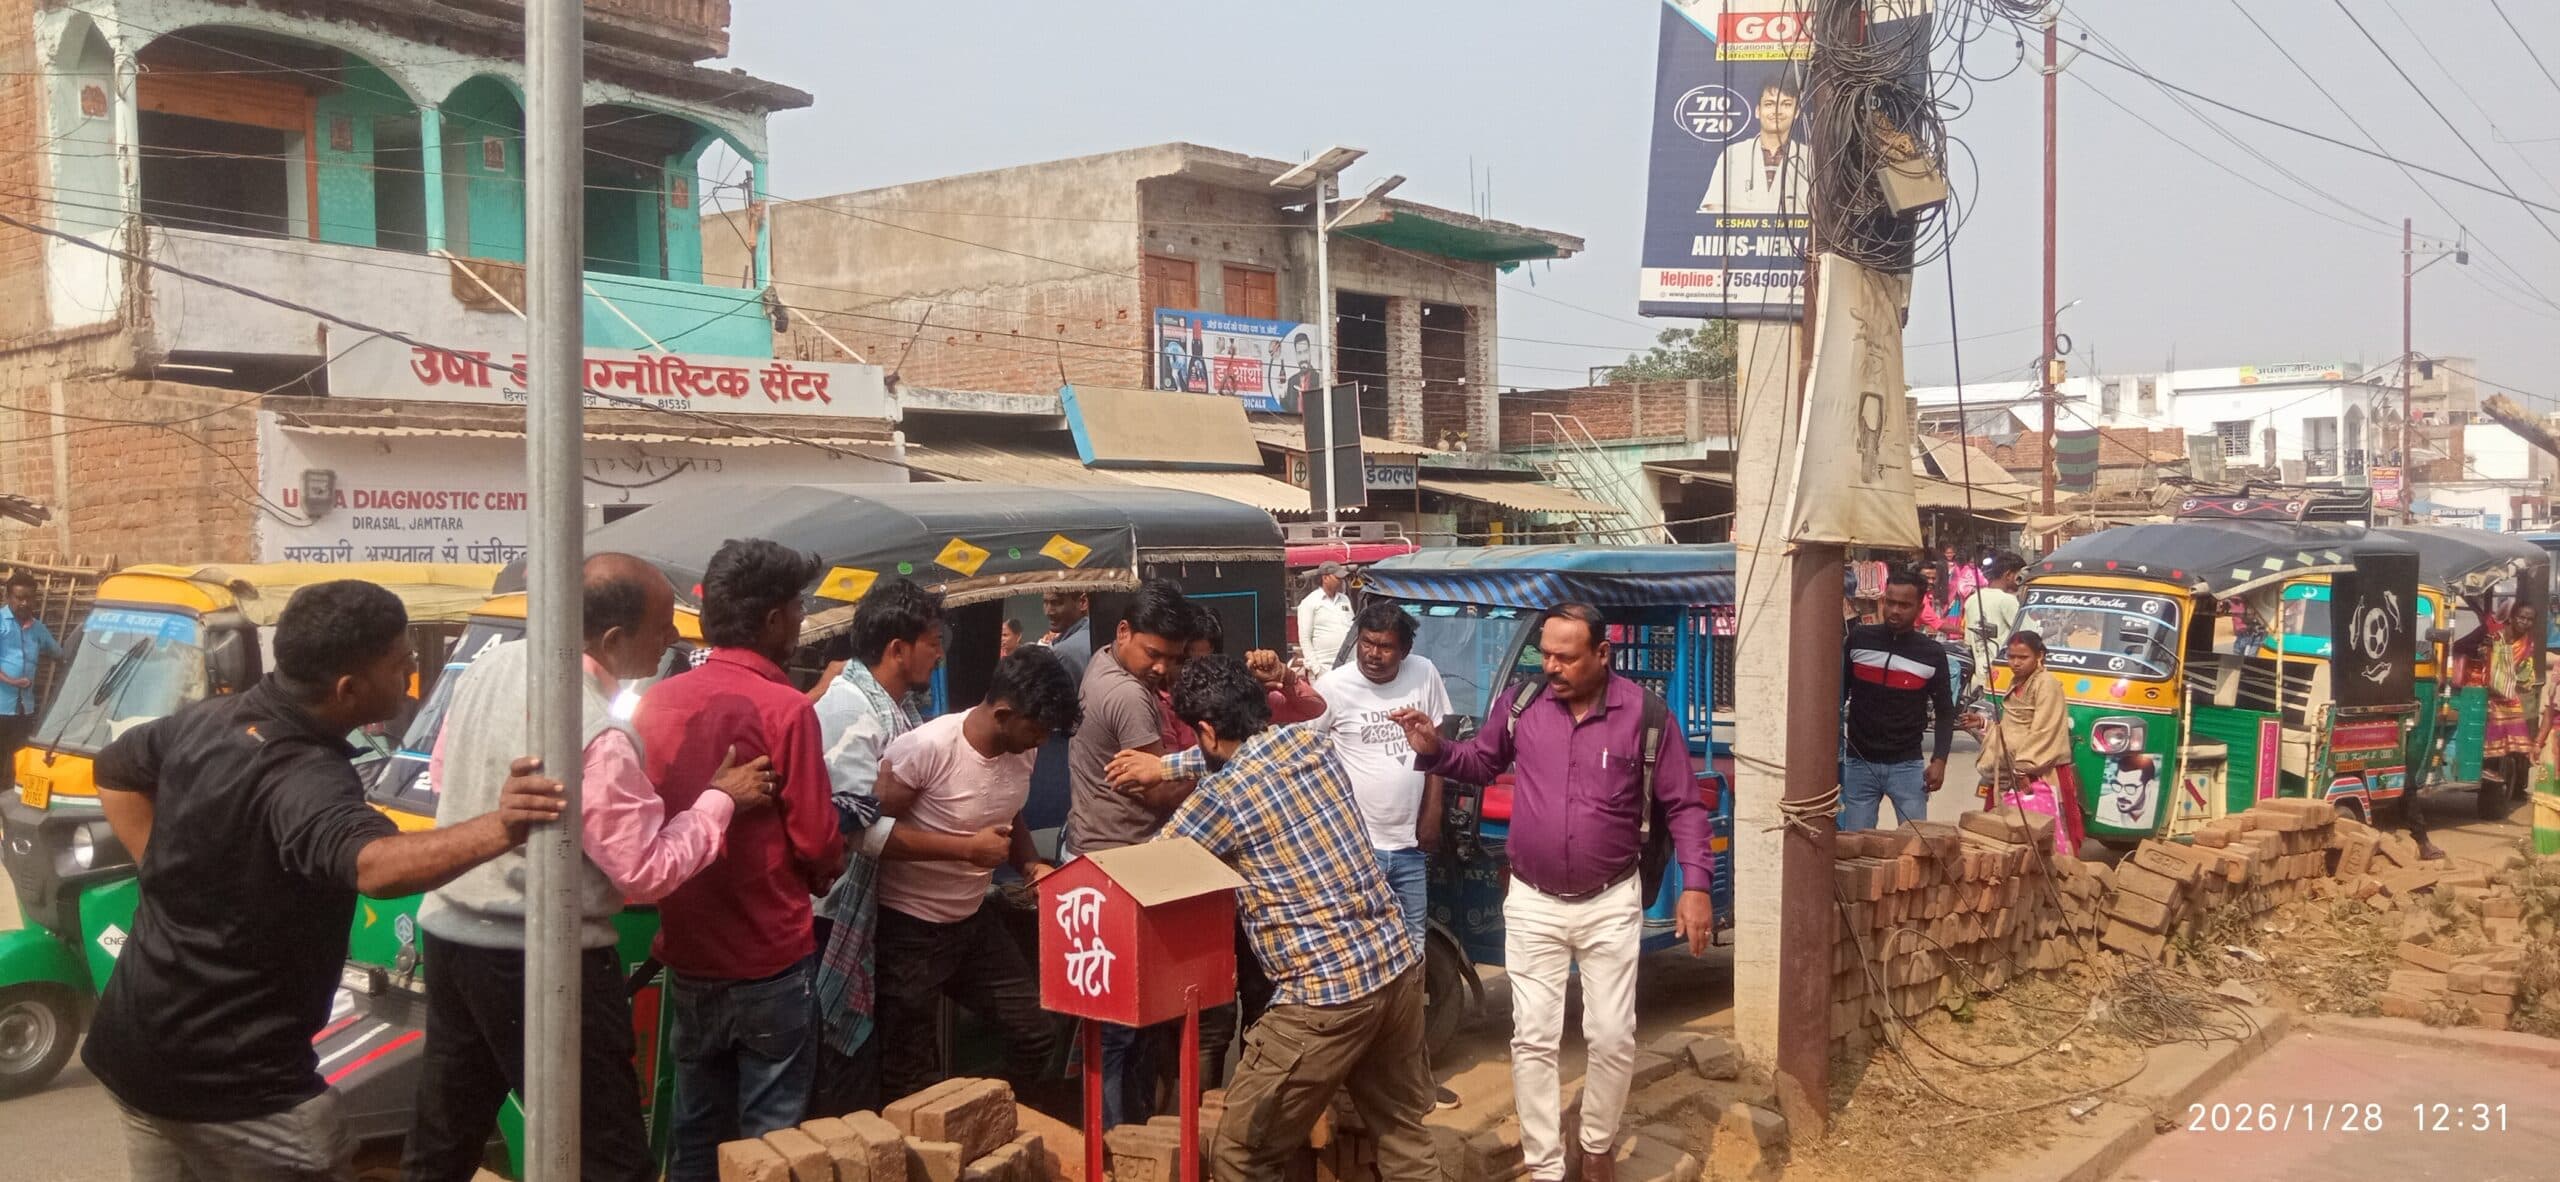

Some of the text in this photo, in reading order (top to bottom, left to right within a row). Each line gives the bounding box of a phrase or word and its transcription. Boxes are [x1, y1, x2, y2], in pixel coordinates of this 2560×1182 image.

[1696, 97, 1731, 112] 710
[1693, 117, 1733, 134] 720
[1660, 272, 1714, 289] Helpline
[1726, 272, 1807, 288] 756490004
[410, 347, 492, 388] उषा
[759, 363, 832, 405] सेंटर
[657, 400, 691, 410] 815351
[353, 489, 480, 511] DIAGNOSTIC
[484, 492, 528, 511] CENT
[409, 516, 463, 530] JAMTARA
[284, 538, 353, 563] सरकारी
[441, 537, 459, 563] से
[1056, 886, 1107, 941] दान
[1064, 937, 1117, 997] पेटी
